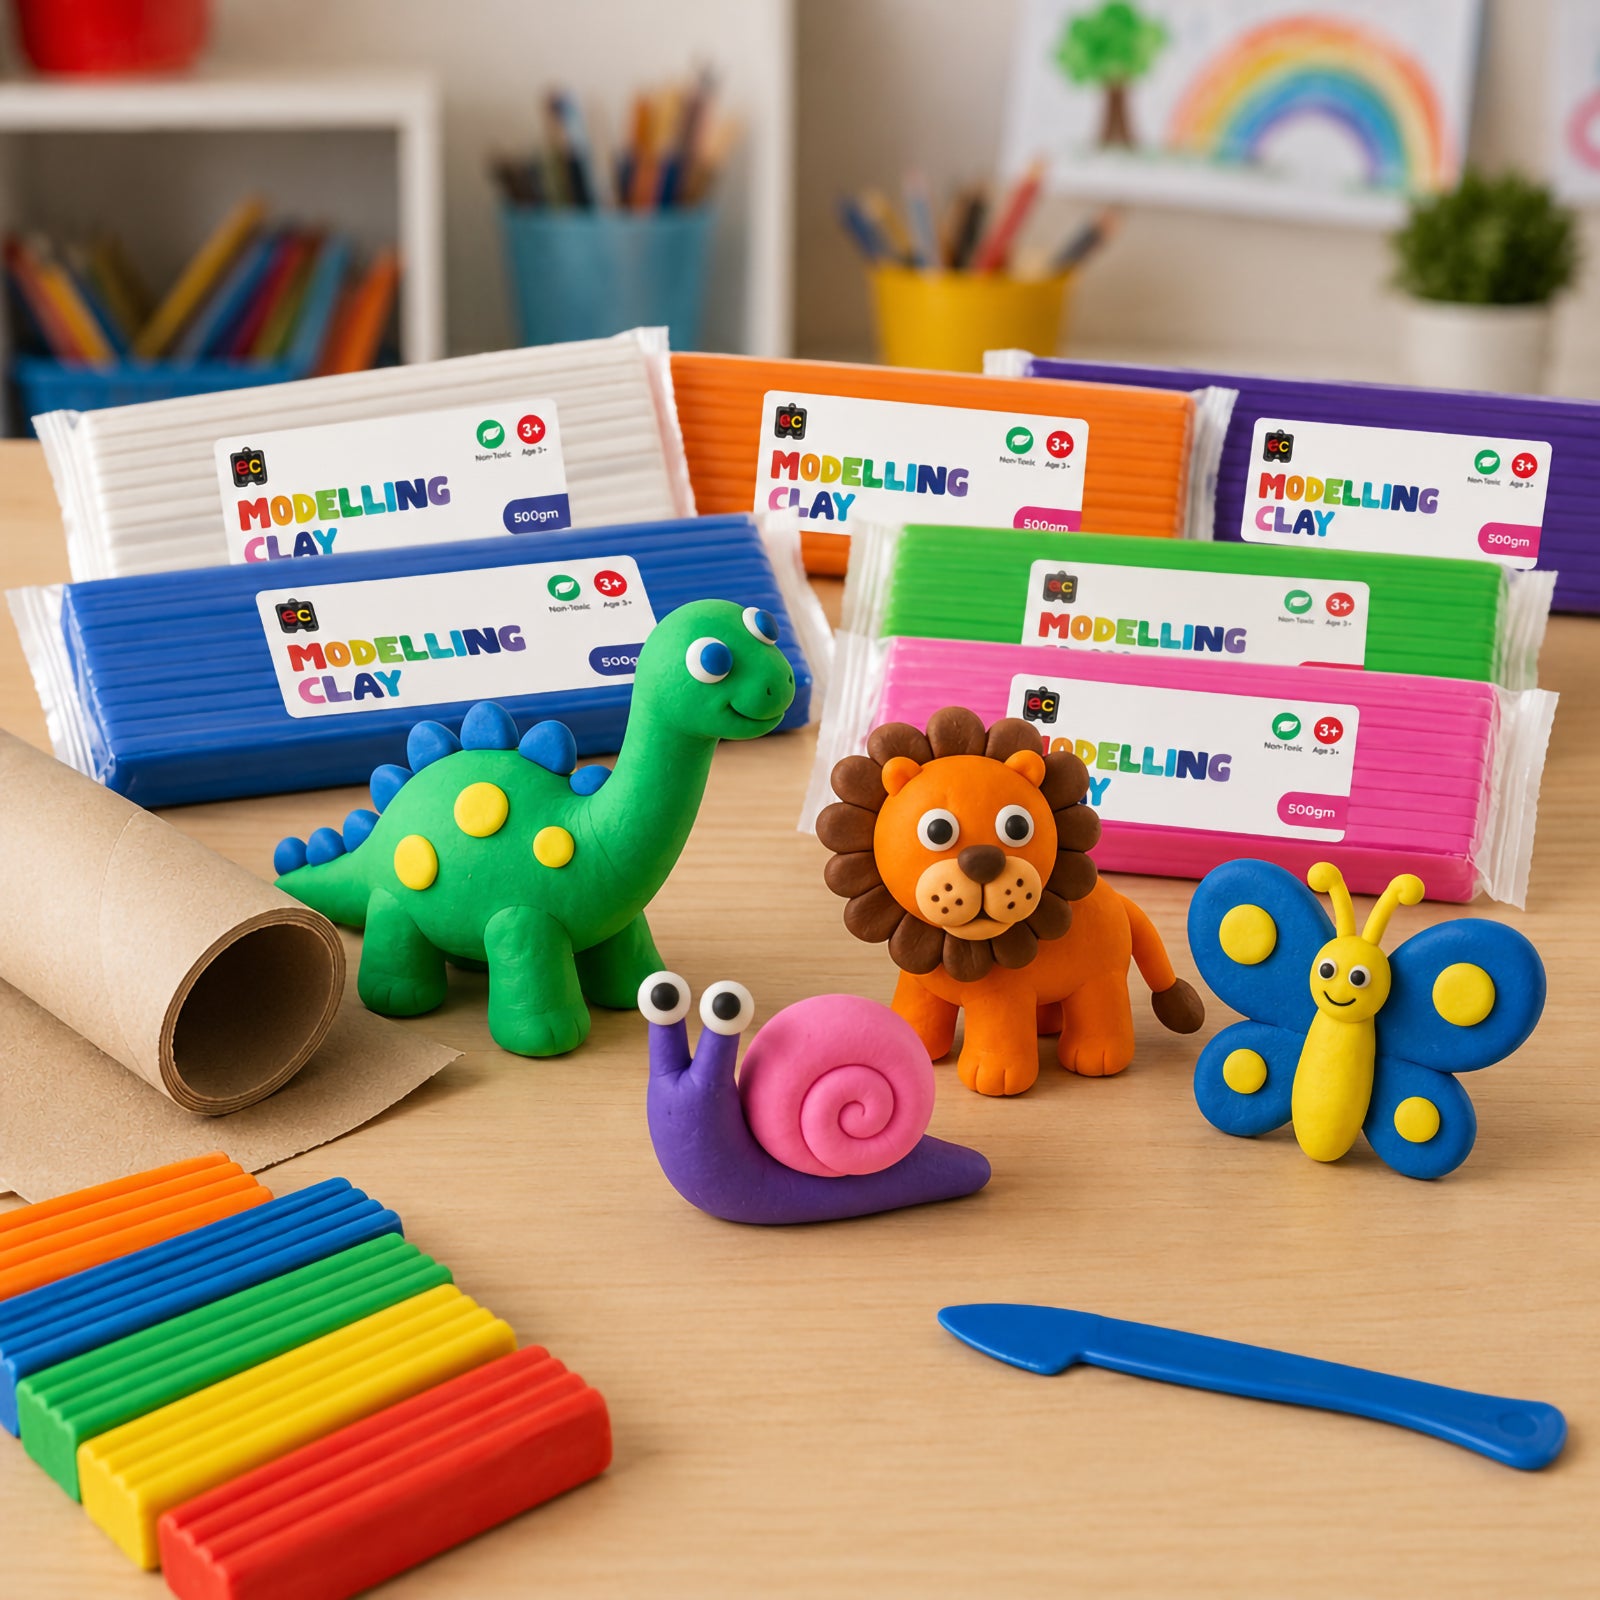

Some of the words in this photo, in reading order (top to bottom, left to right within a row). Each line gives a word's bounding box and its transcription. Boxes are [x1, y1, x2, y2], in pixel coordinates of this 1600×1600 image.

[522, 423, 541, 437] 3+
[1051, 437, 1070, 451] 3+
[475, 451, 512, 462] Non-Toxic
[522, 448, 536, 456] Age
[236, 459, 262, 475] ec
[1045, 461, 1059, 469] Age
[1516, 459, 1534, 471] 3+
[770, 449, 970, 497] MODELLING
[1509, 480, 1523, 488] Age
[1258, 472, 1440, 514] MODELLING
[237, 475, 451, 531] MODELLING
[768, 486, 856, 521] CLAY
[513, 510, 559, 523] 500gm
[1255, 505, 1335, 537] CLAY
[244, 527, 338, 563] CLAY
[1487, 533, 1530, 548] 500gm
[600, 578, 622, 591] 3+
[603, 600, 620, 608] Age
[1330, 598, 1351, 611] 3+
[281, 609, 311, 623] ec
[1038, 611, 1248, 654] MODELLING
[287, 625, 527, 672] MODELLING
[298, 669, 402, 704] CLAY
[1028, 697, 1054, 712] ec
[1319, 723, 1340, 737] 3+
[1264, 741, 1303, 752] Non-Toxic
[1312, 746, 1328, 755] Age
[1042, 735, 1233, 782] ODELLING
[1287, 803, 1336, 819] 500gm
